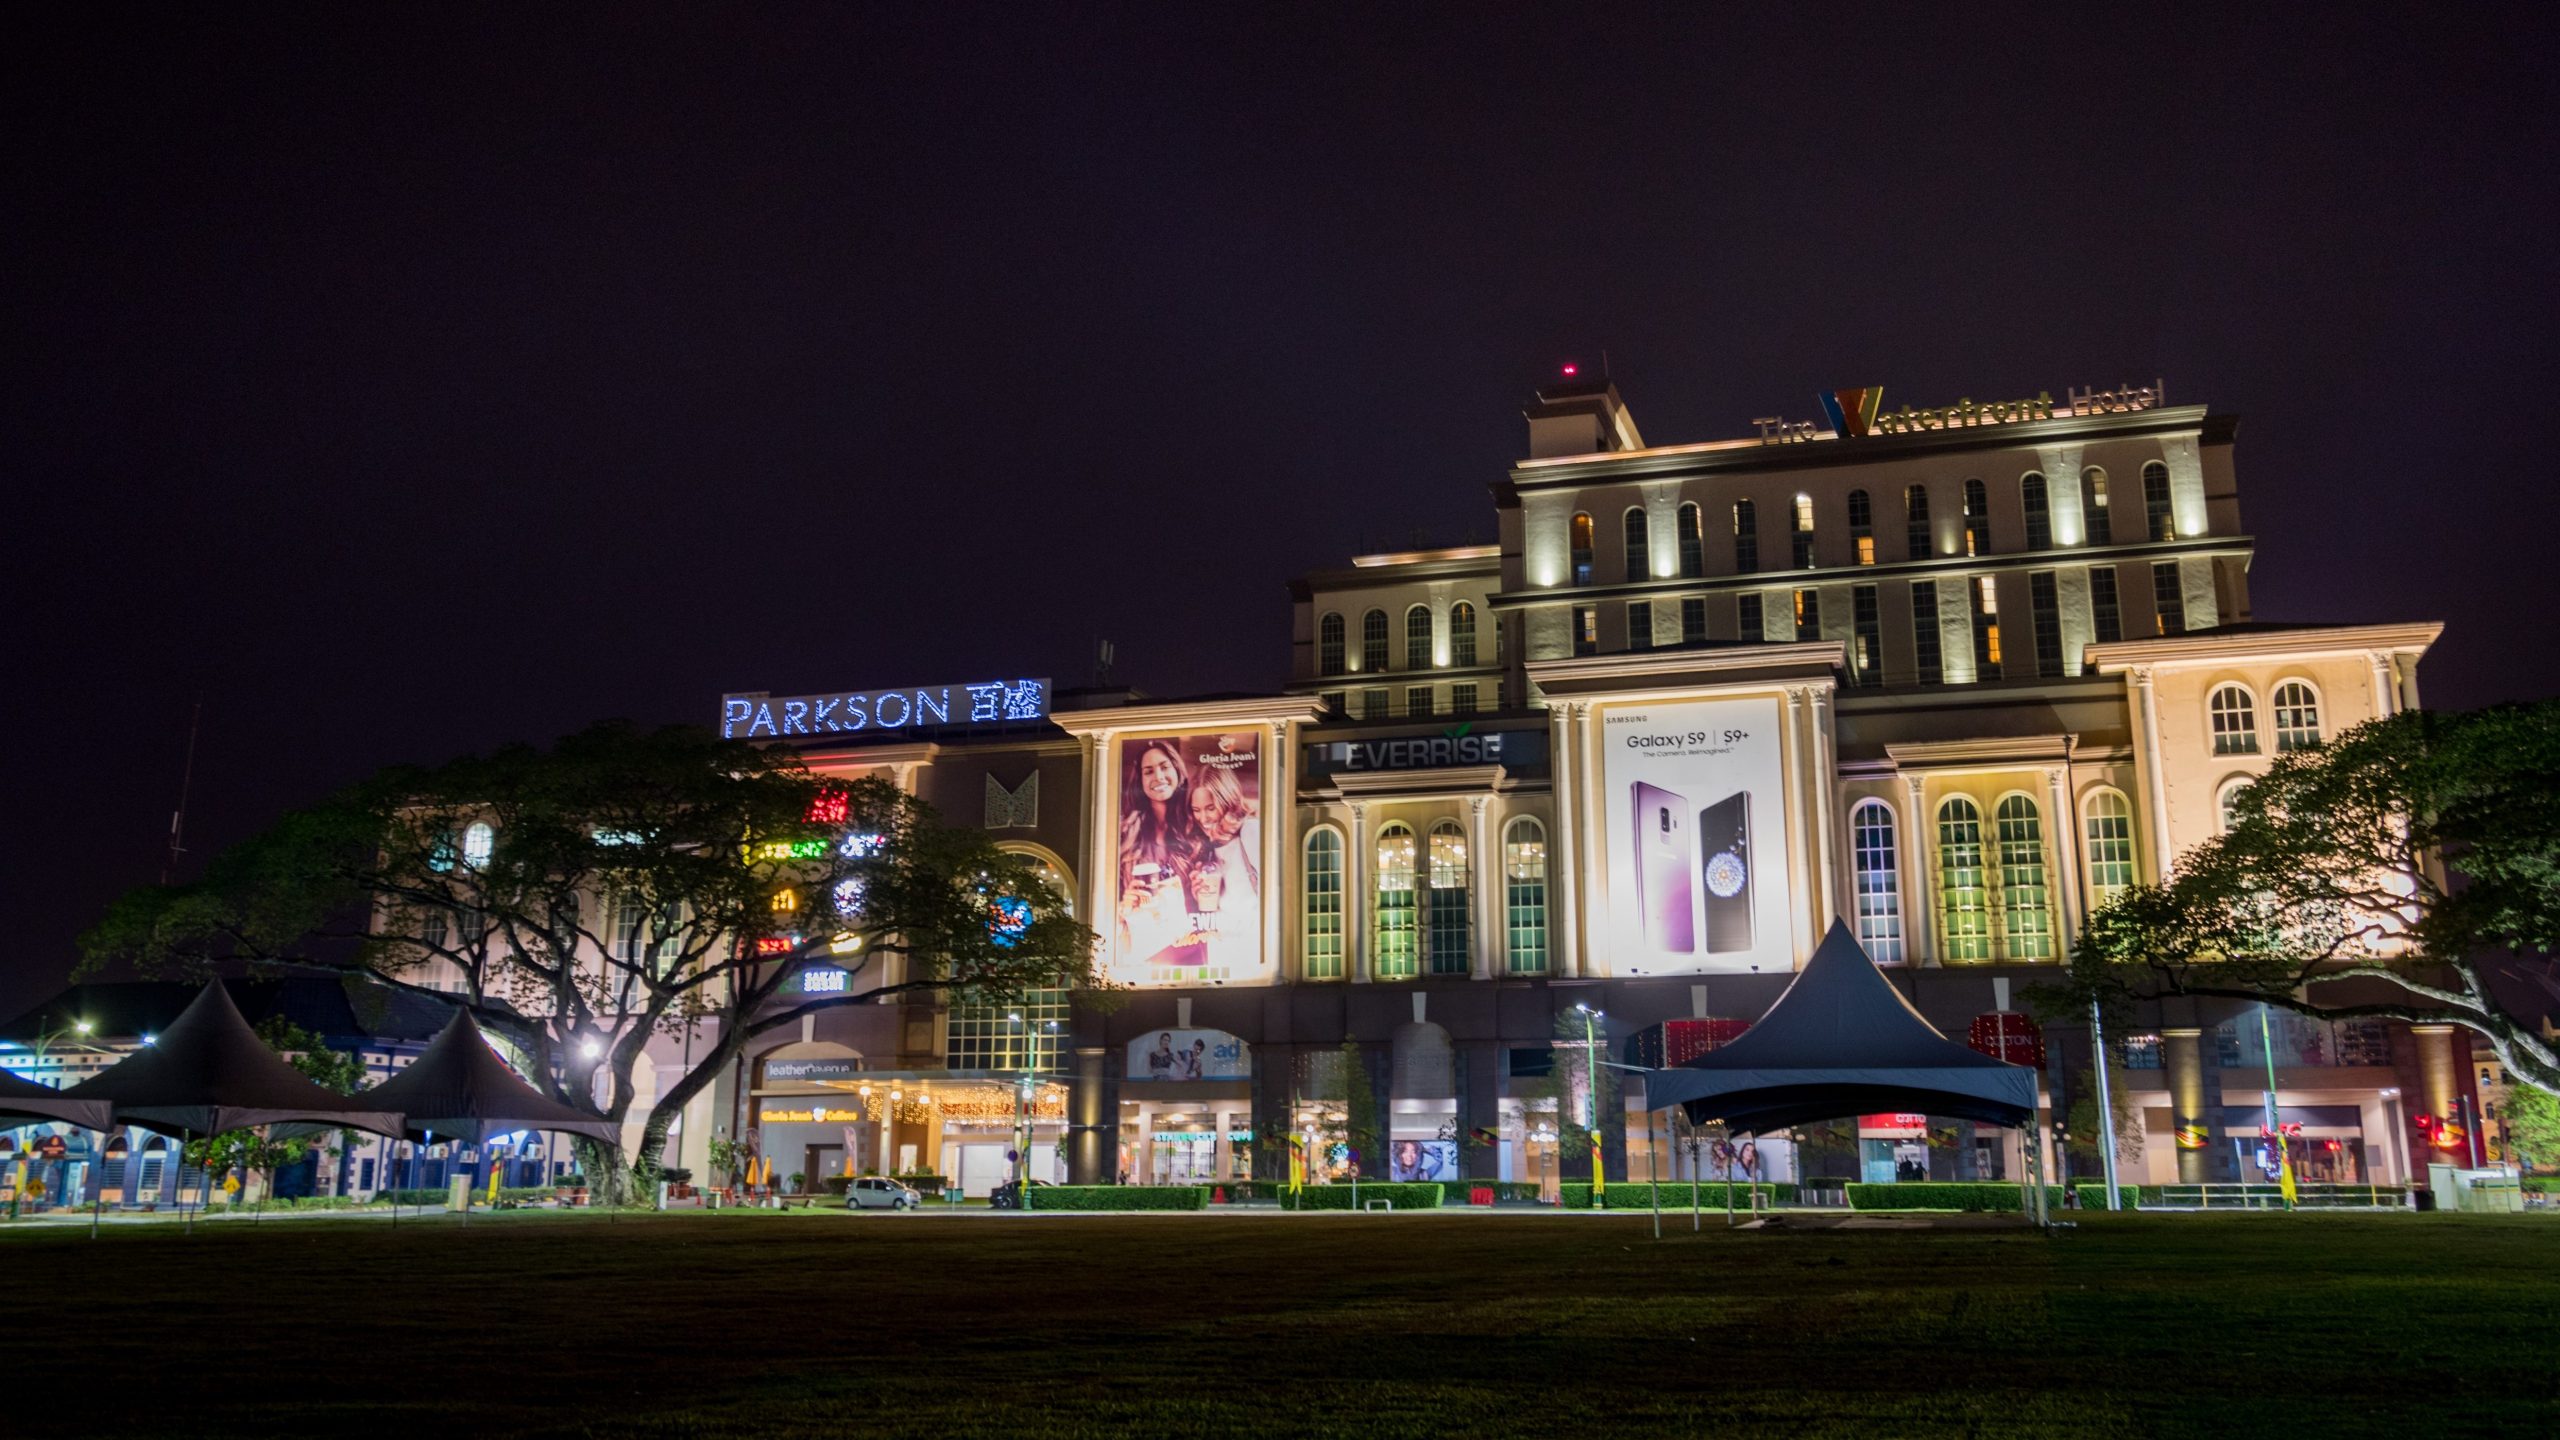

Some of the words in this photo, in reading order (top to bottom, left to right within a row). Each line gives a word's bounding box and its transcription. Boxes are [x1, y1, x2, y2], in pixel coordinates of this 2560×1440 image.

[1752, 416, 1817, 446] The
[1818, 386, 2053, 440] Waterfront
[2068, 378, 2164, 417] Hotel
[724, 687, 950, 739] PARKSON
[966, 679, 1044, 722] 百盛
[1605, 715, 1648, 724] SAMSUNG
[1345, 734, 1501, 770] EVERRISE
[1626, 734, 1685, 749] Galaxy
[1687, 731, 1706, 745] S9
[1723, 729, 1750, 744] S9+
[1199, 752, 1229, 764] Gloria
